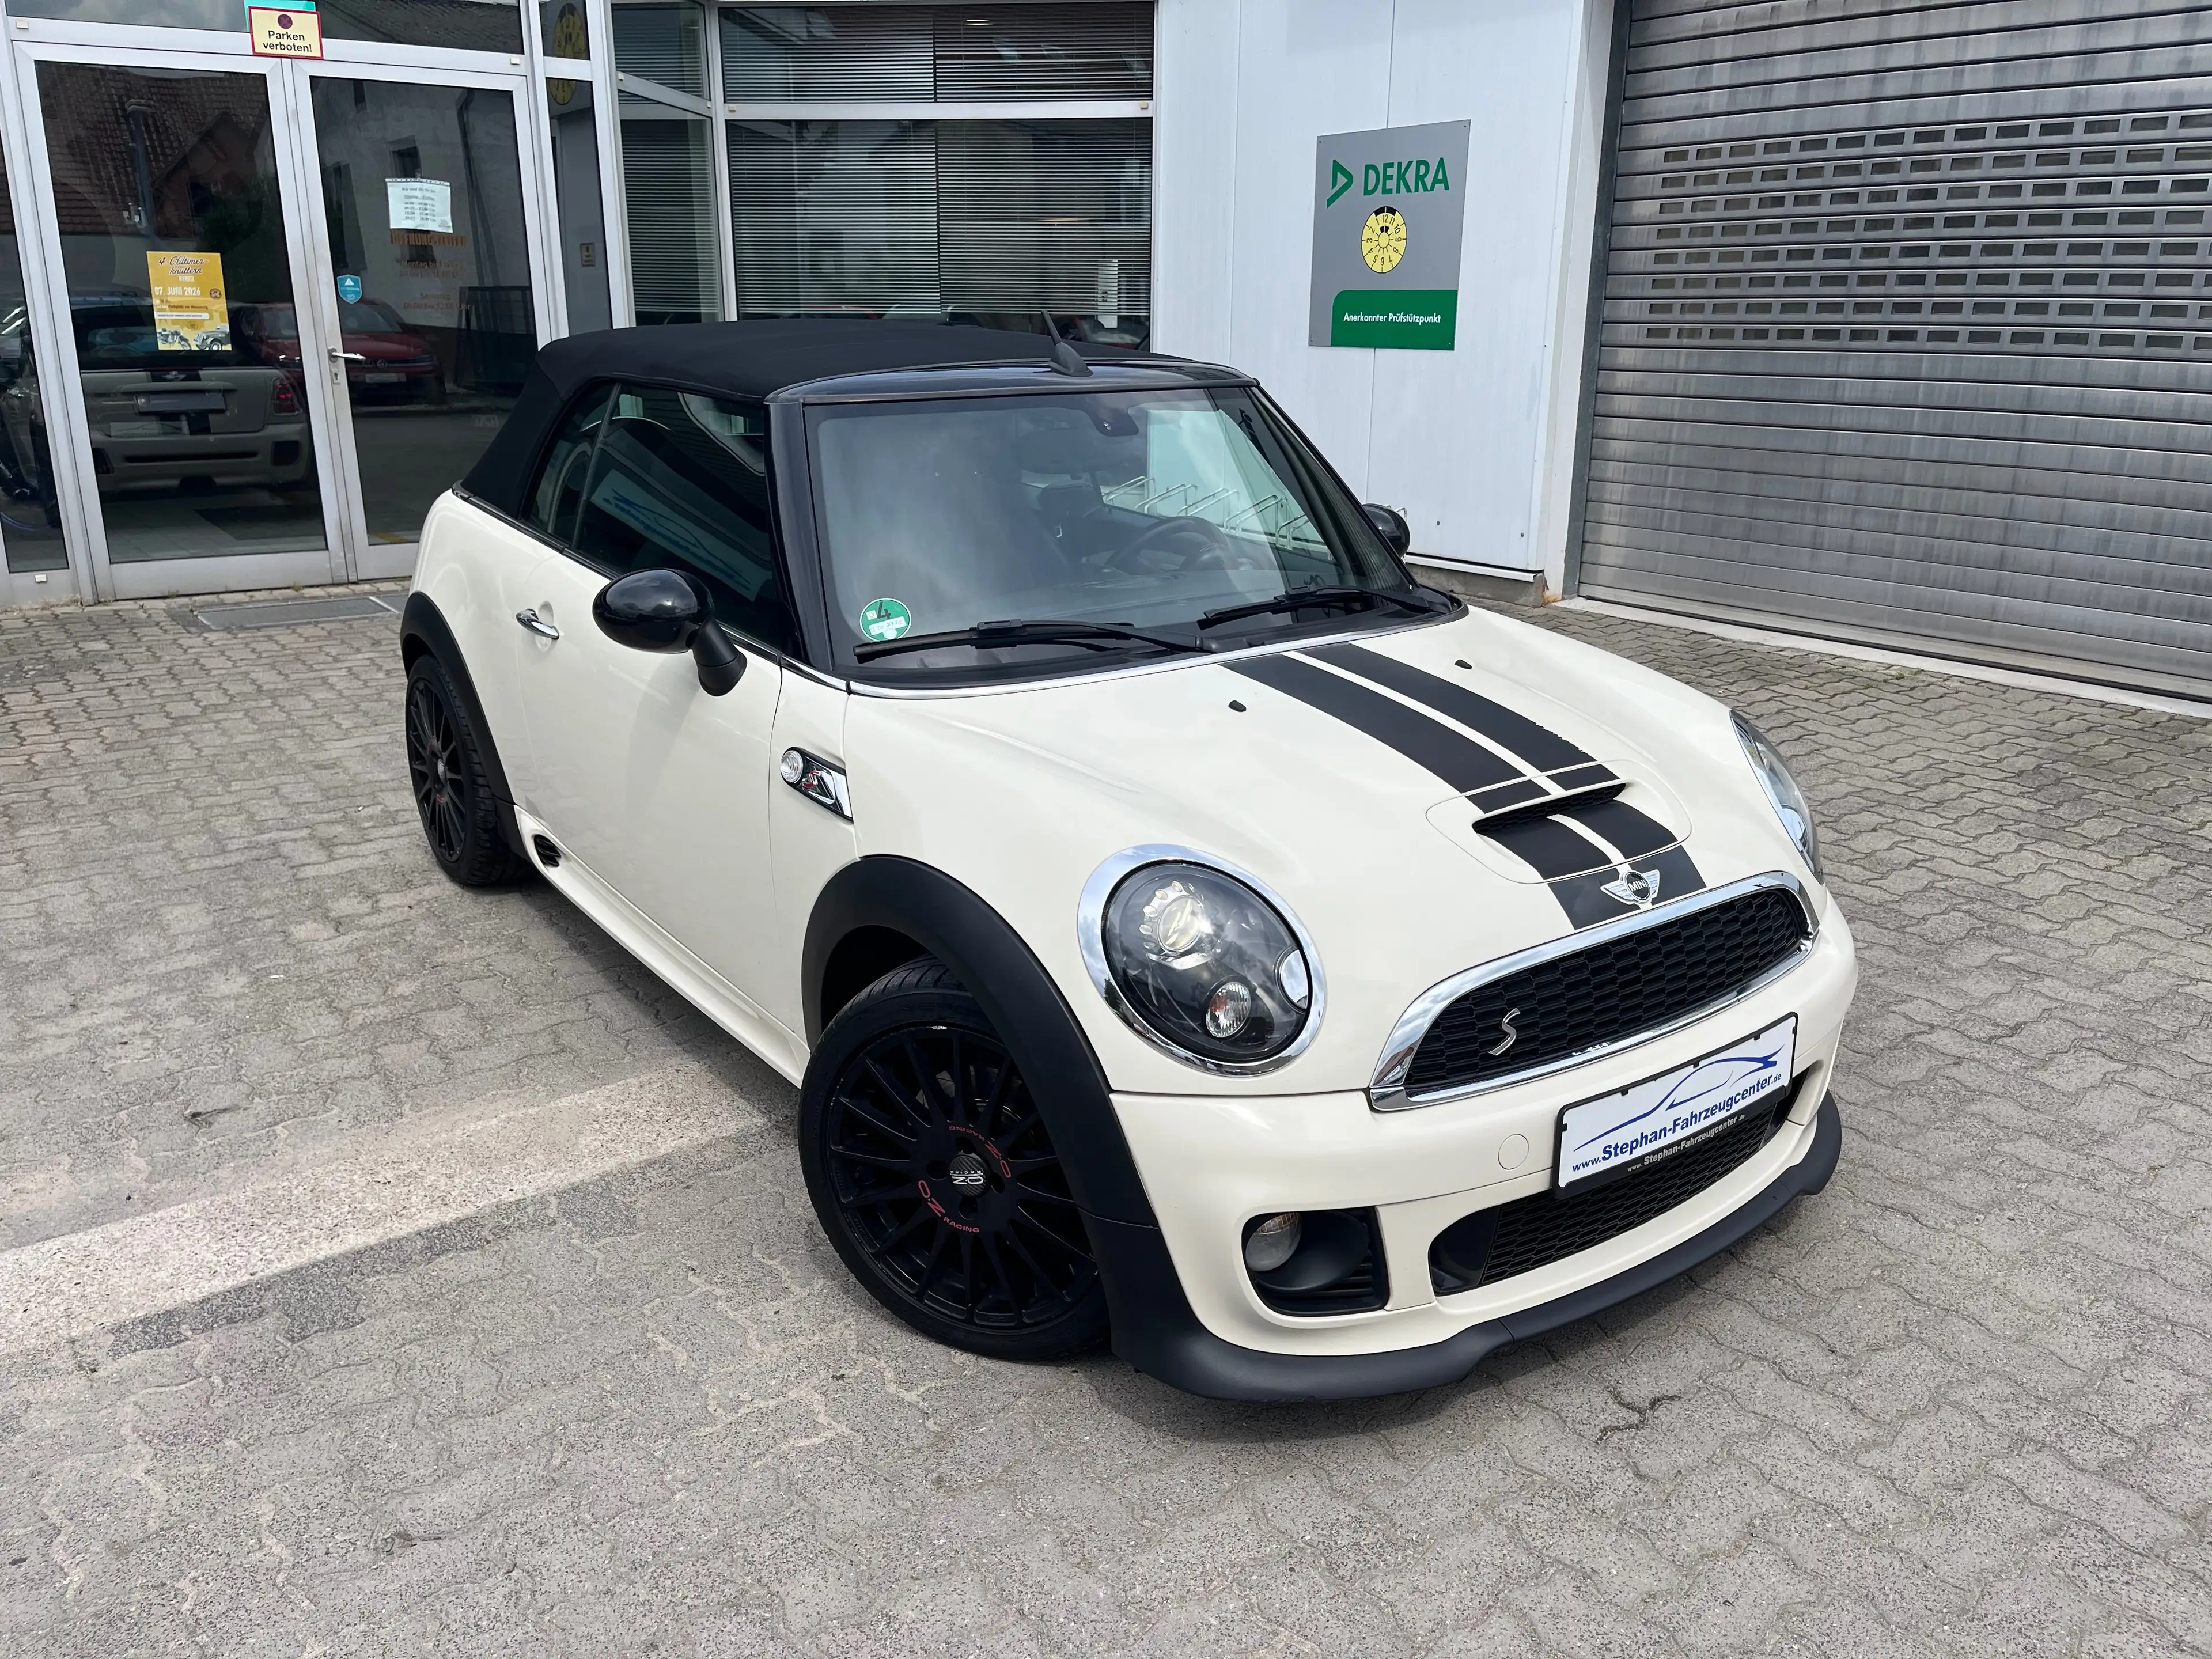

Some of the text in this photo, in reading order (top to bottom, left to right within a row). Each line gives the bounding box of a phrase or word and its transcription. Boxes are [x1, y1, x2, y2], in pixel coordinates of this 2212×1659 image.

[268, 30, 305, 41] Parken
[263, 42, 312, 52] verboten!
[1363, 157, 1449, 196] DEKRA
[1382, 214, 1388, 223] 12
[1389, 216, 1395, 226] 11
[1393, 224, 1401, 234] 10
[167, 287, 183, 296] JUNI
[184, 287, 201, 296] 2026
[1343, 312, 1441, 325] Anerkannter Prüfstützpunkt
[877, 601, 891, 619] 4
[1628, 880, 1647, 892] MINI
[1487, 1008, 1521, 1056] S
[1572, 1073, 1782, 1173] www.Stephan-Fahrzeugcenter.de
[948, 1125, 986, 1141] RACING
[944, 1215, 980, 1233] RACING
